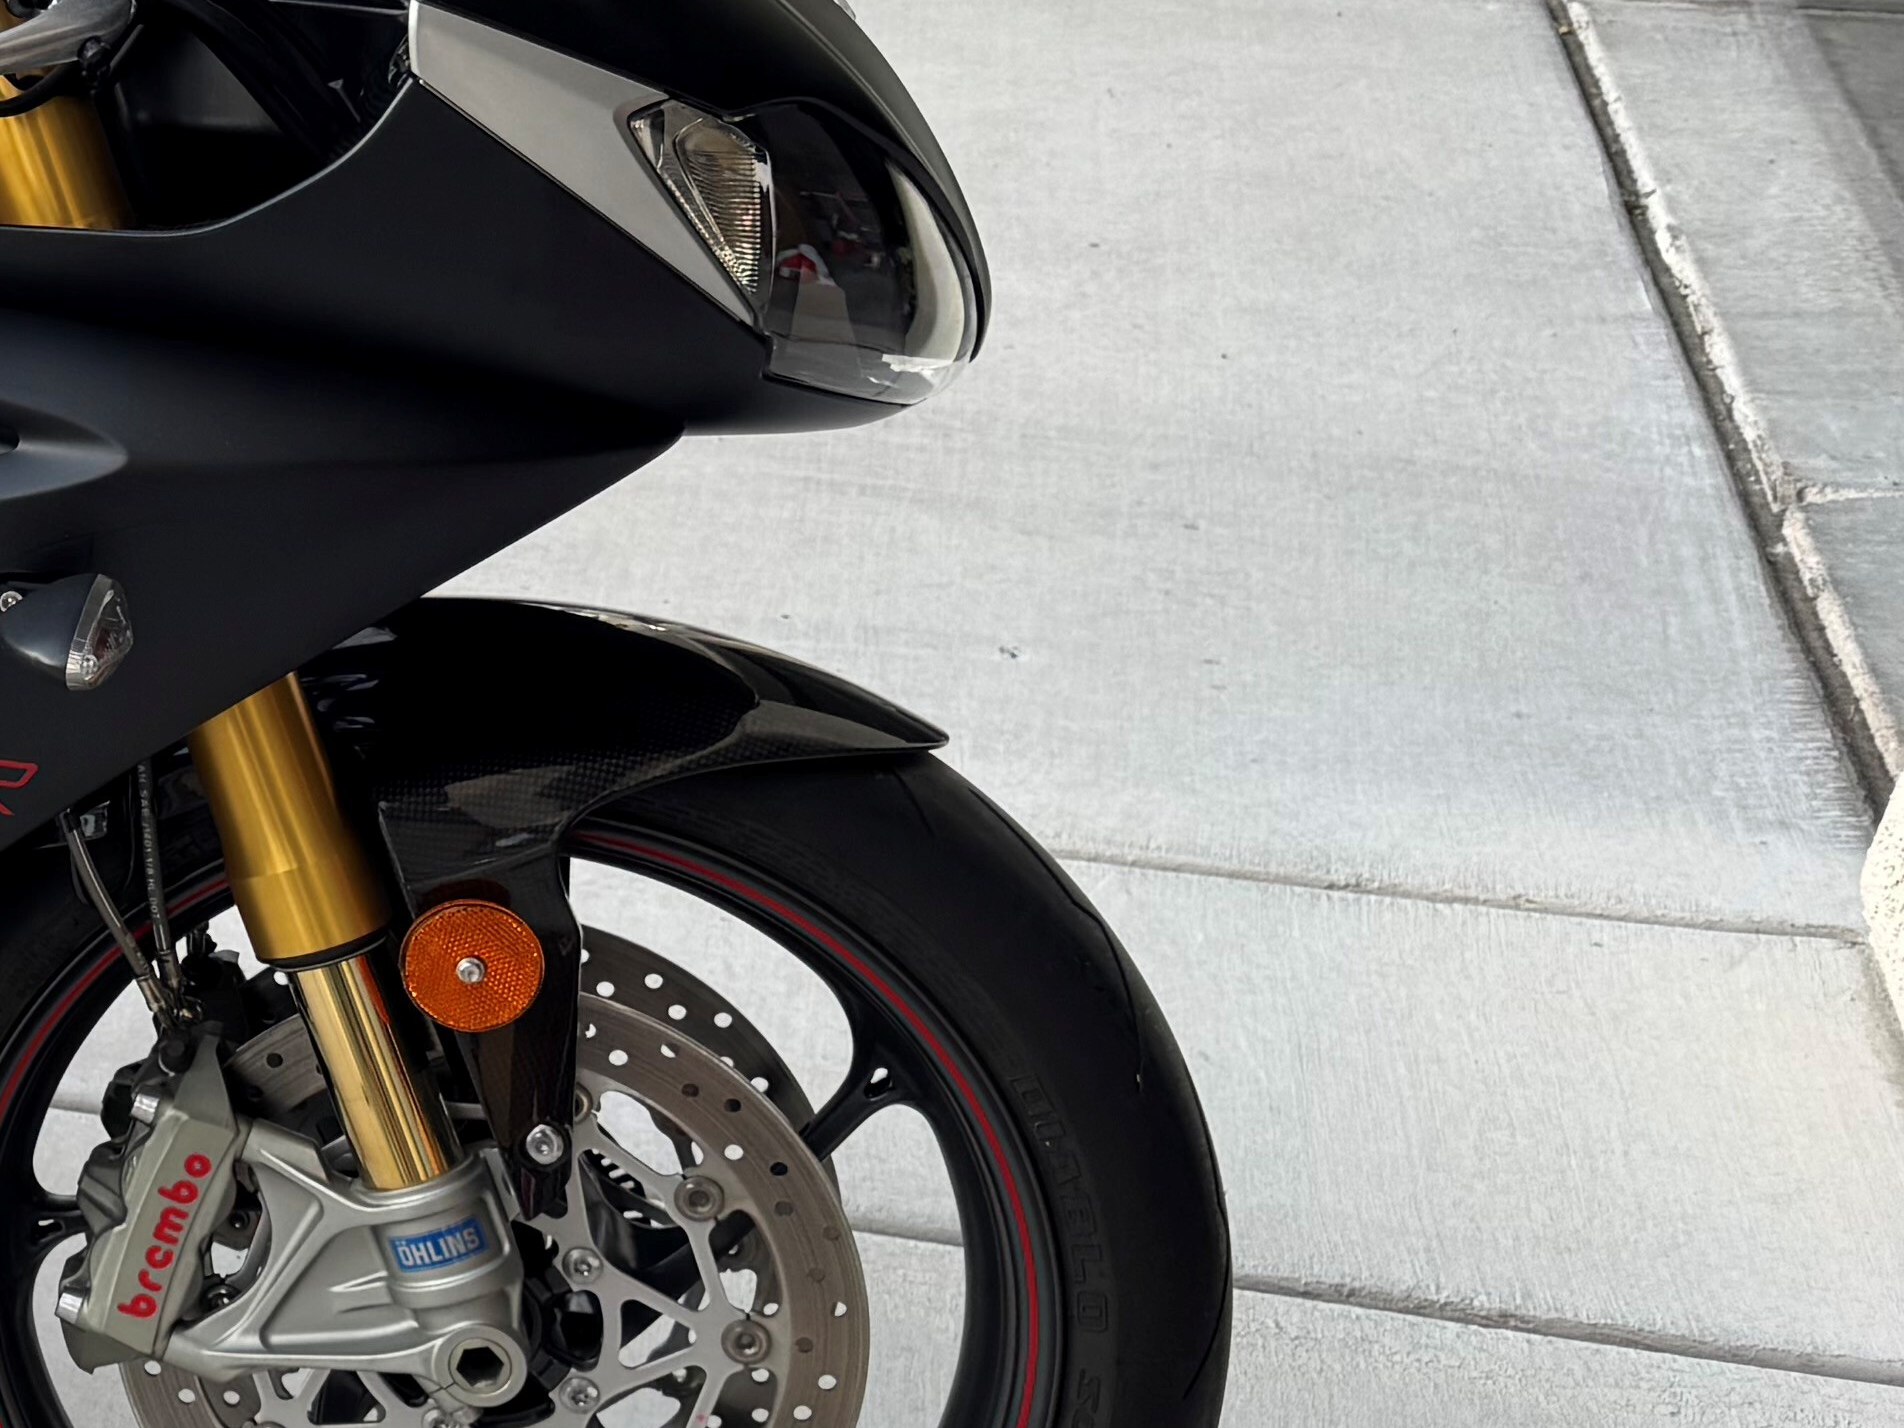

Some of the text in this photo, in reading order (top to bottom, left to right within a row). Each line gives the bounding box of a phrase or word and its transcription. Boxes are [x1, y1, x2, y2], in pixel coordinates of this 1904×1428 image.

[118, 1153, 211, 1318] brembo
[397, 1227, 480, 1266] ÖHLINS
[1006, 1068, 1109, 1333] DIABLO
